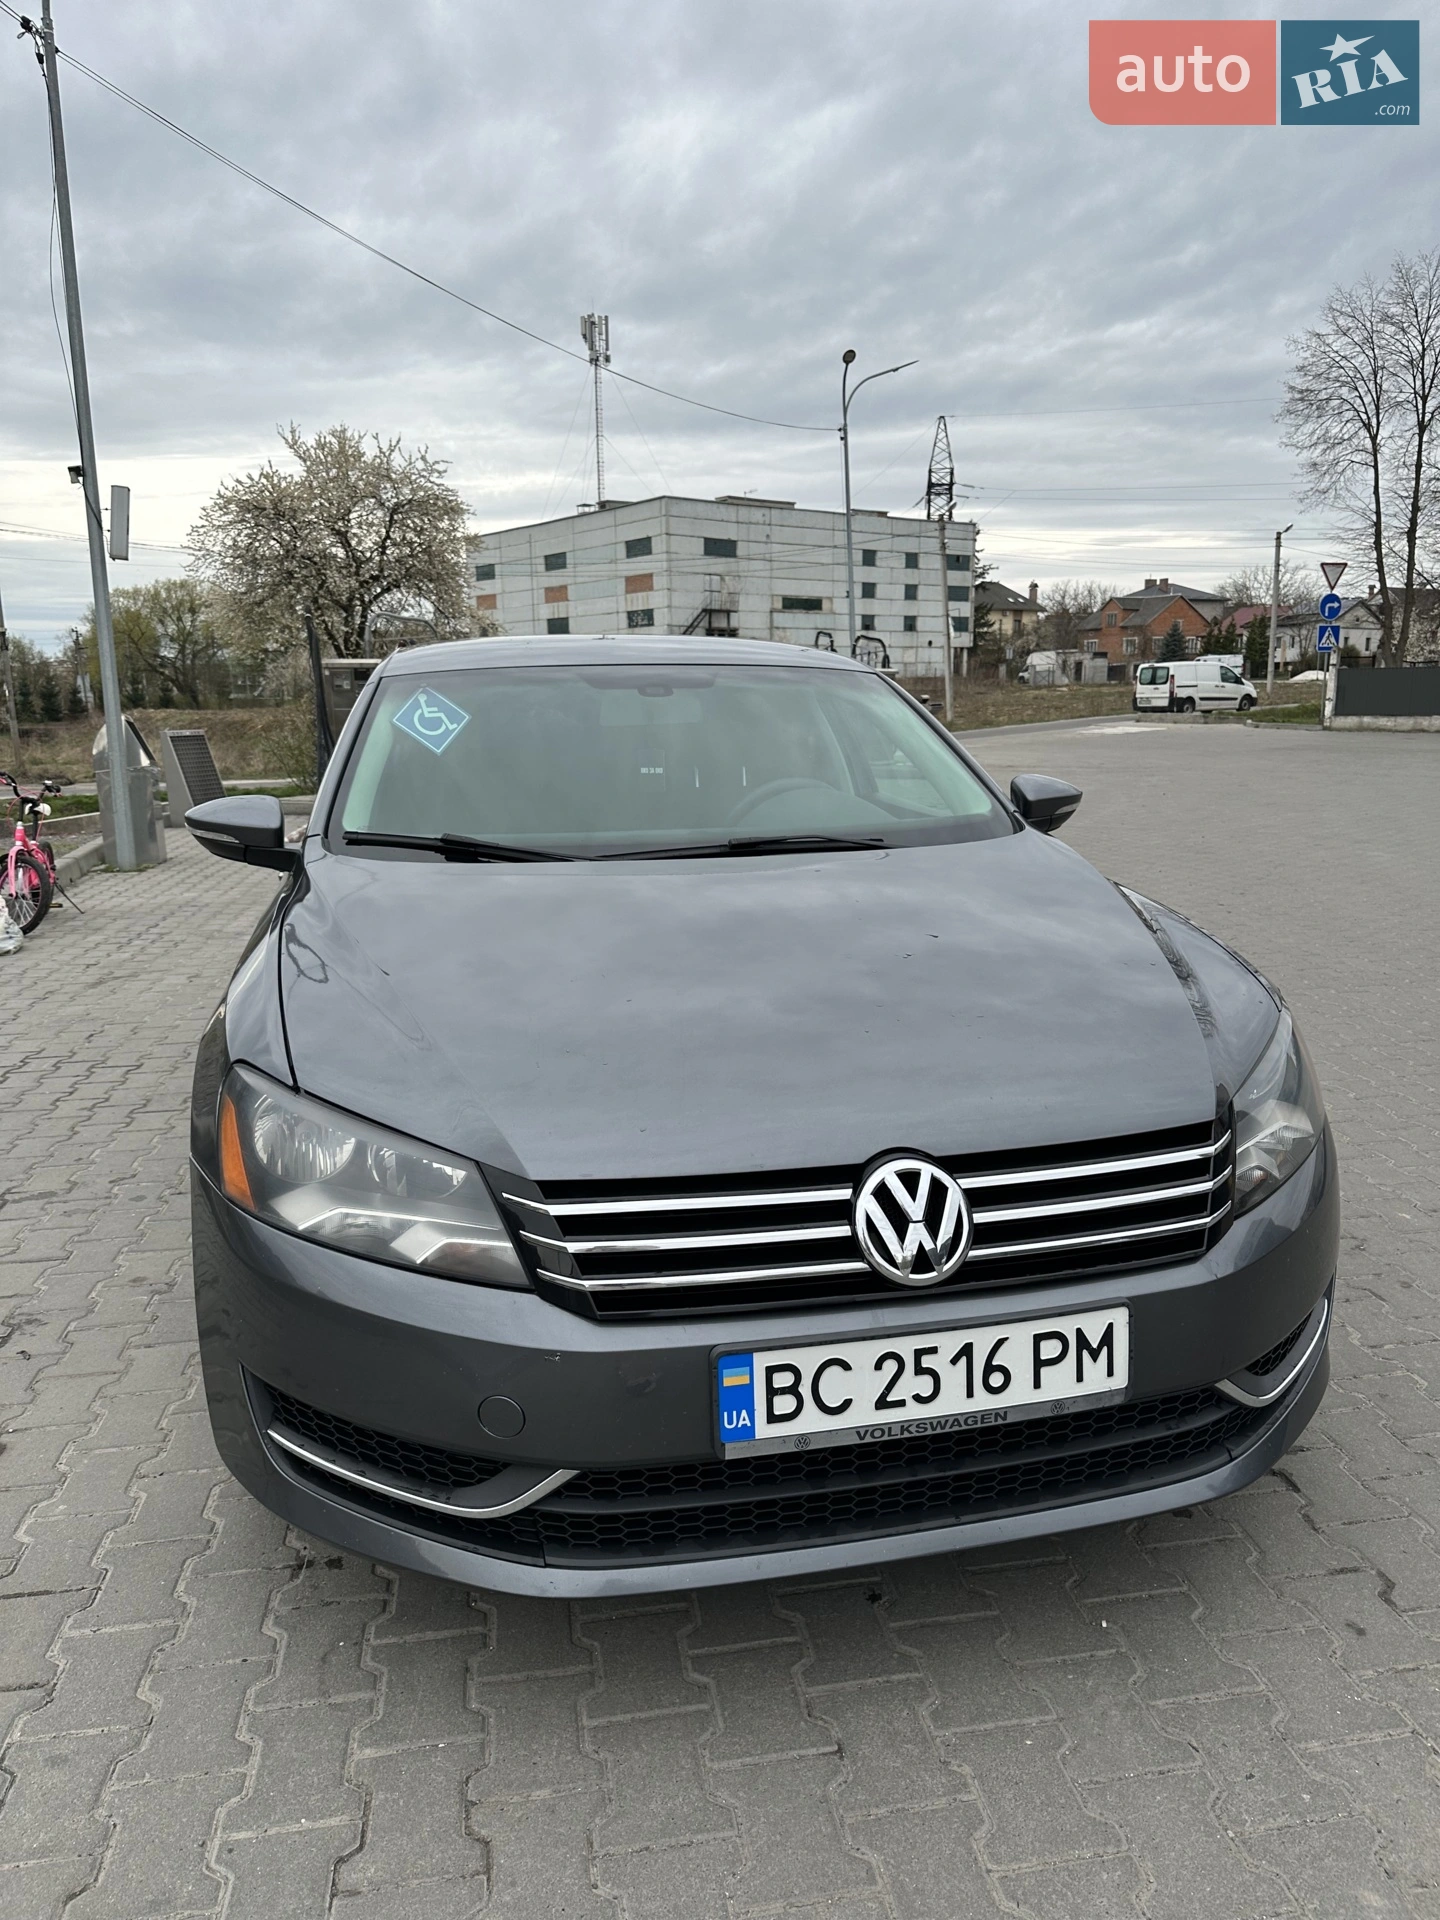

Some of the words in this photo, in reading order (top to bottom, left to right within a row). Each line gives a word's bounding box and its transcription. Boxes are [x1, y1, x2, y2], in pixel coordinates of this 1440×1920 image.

[856, 1158, 969, 1286] VW
[764, 1357, 853, 1425] BC
[874, 1336, 1013, 1411] 2516
[1032, 1321, 1115, 1390] PM
[723, 1410, 752, 1430] UA
[855, 1410, 1009, 1441] VOLKSWAGEN
